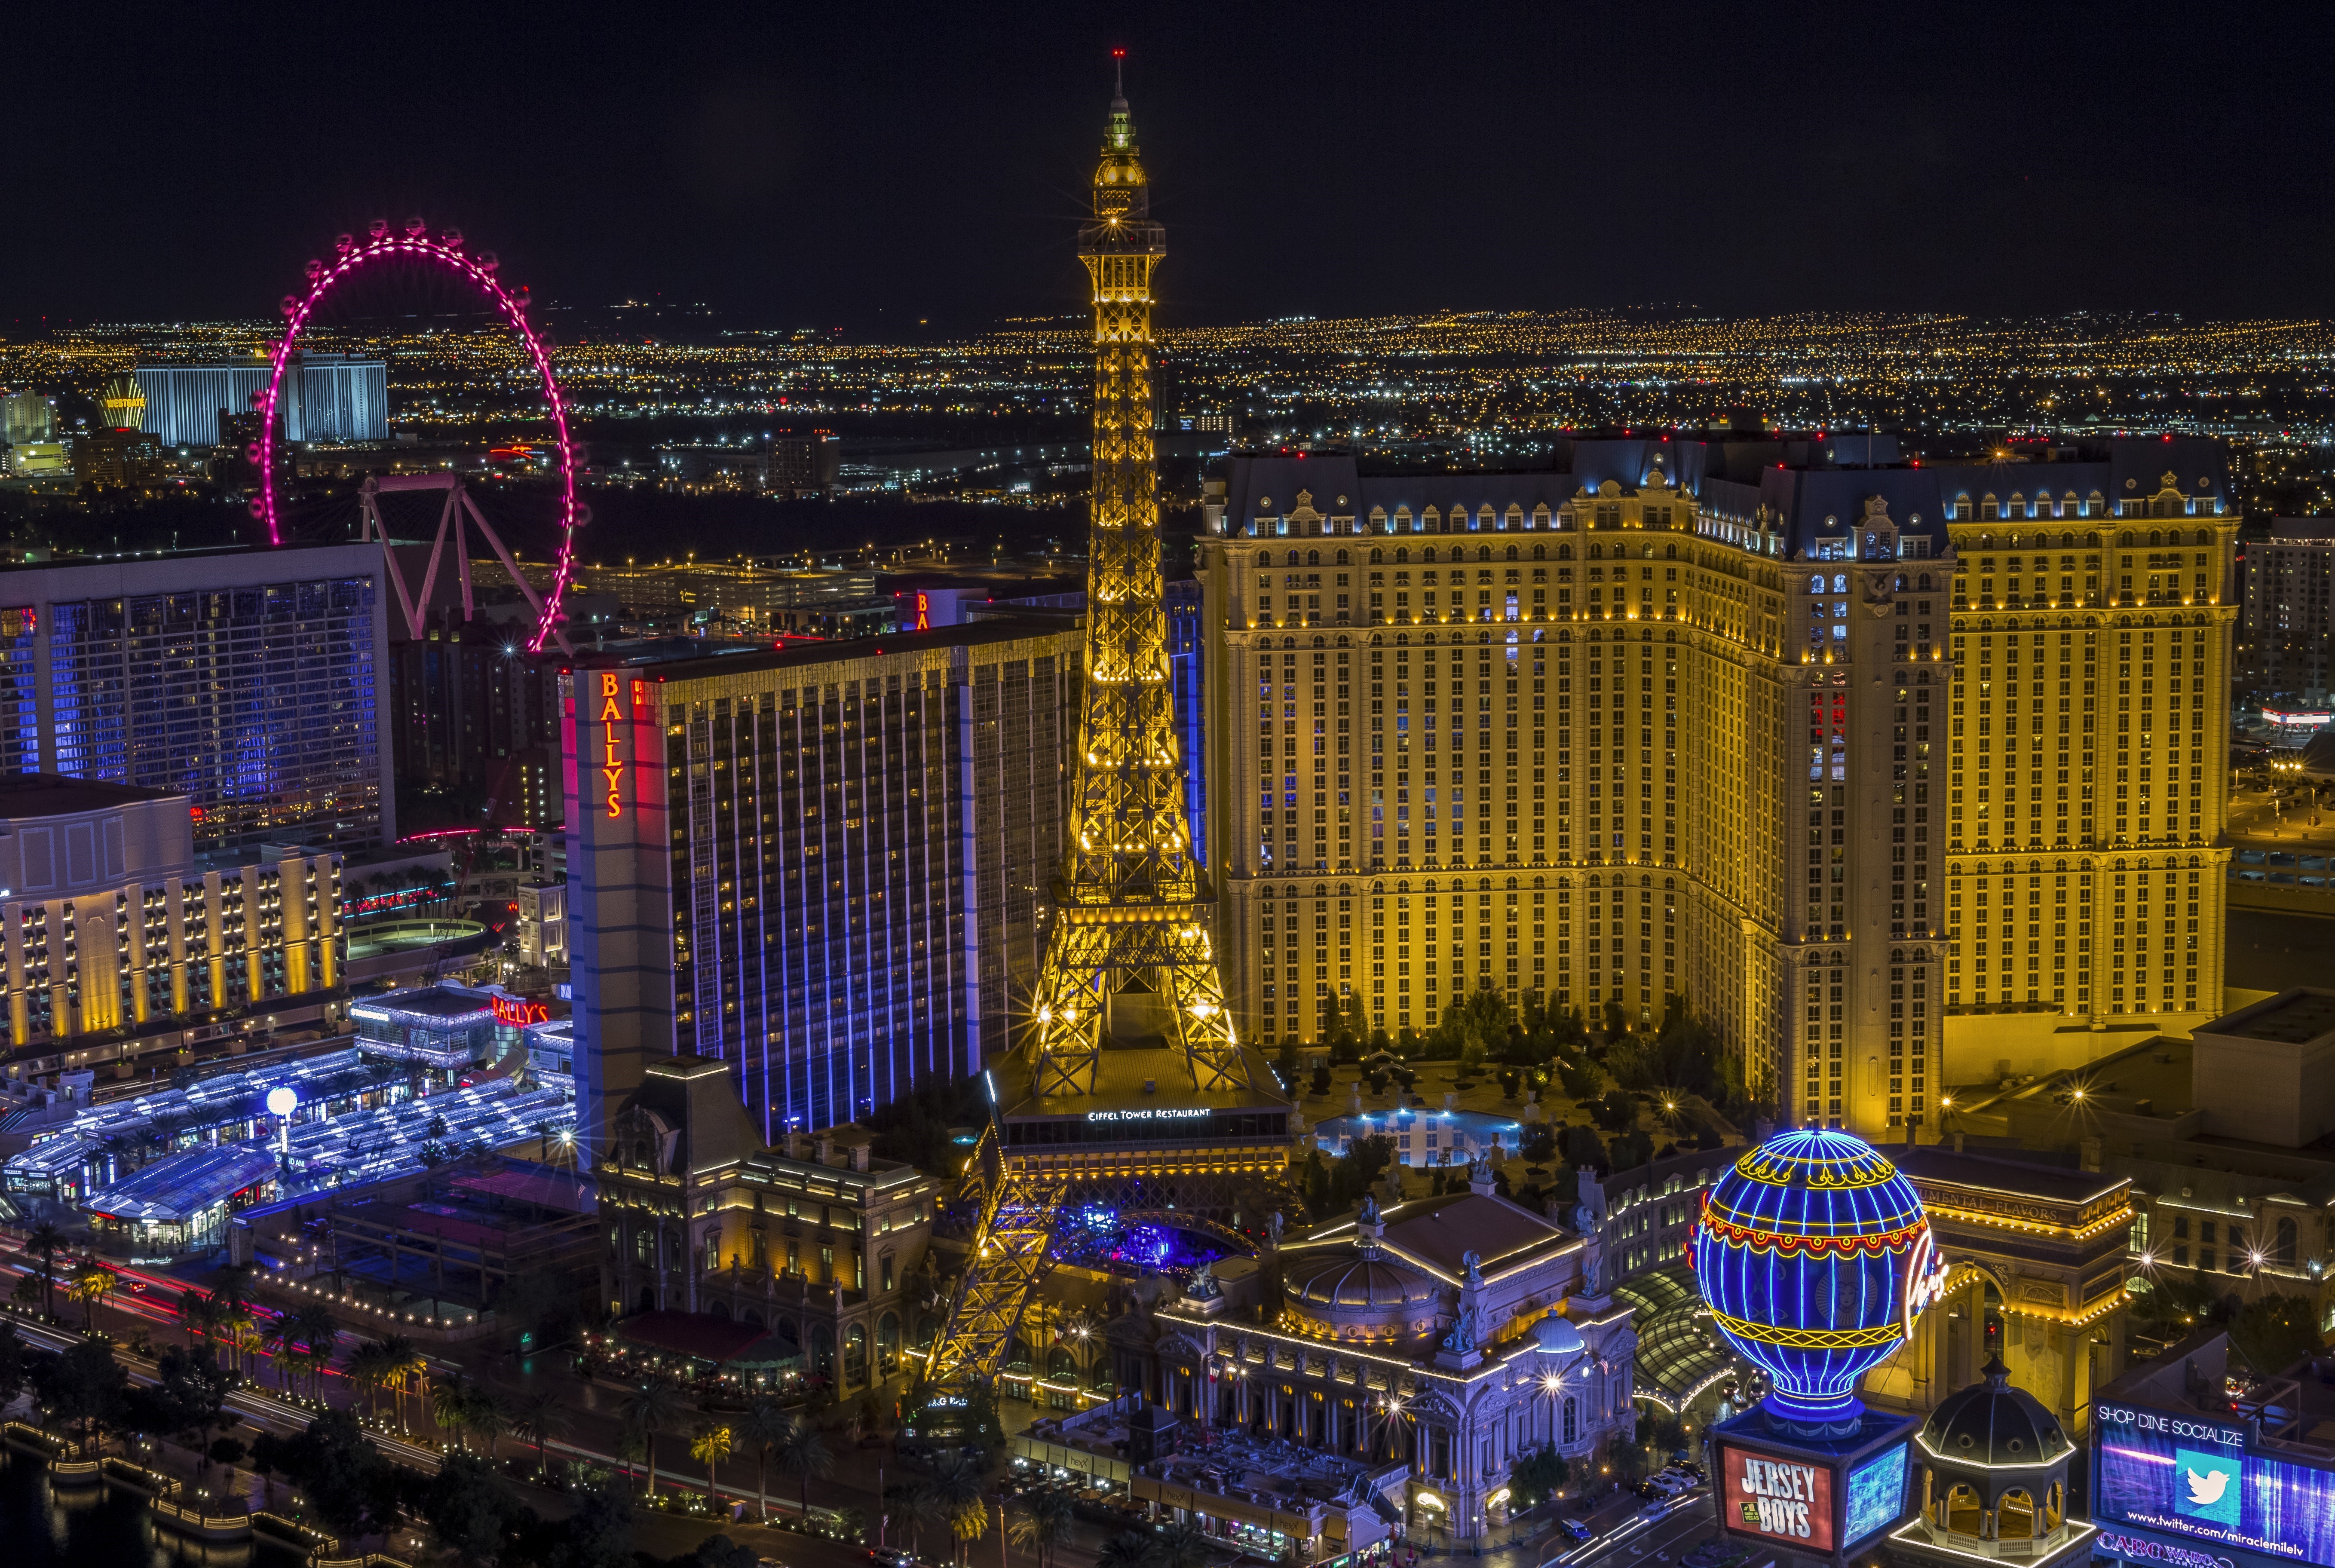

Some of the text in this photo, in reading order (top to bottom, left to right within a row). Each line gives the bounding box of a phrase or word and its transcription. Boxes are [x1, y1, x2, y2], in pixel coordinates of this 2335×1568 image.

[107, 398, 144, 408] WESTGATE
[492, 996, 548, 1024] BALLY'S
[295, 1159, 305, 1167] ANI
[1995, 1201, 2057, 1220] FLAVORS
[1899, 1228, 1949, 1340] Paris
[2099, 1406, 2243, 1447] SHOP DINE SOCIALIZE
[1741, 1458, 1815, 1503] JERSEY
[1757, 1497, 1811, 1538] BOYS
[2127, 1511, 2304, 1557] www.twitter.com/miraclemilelv
[2096, 1531, 2215, 1567] CABO WABO
